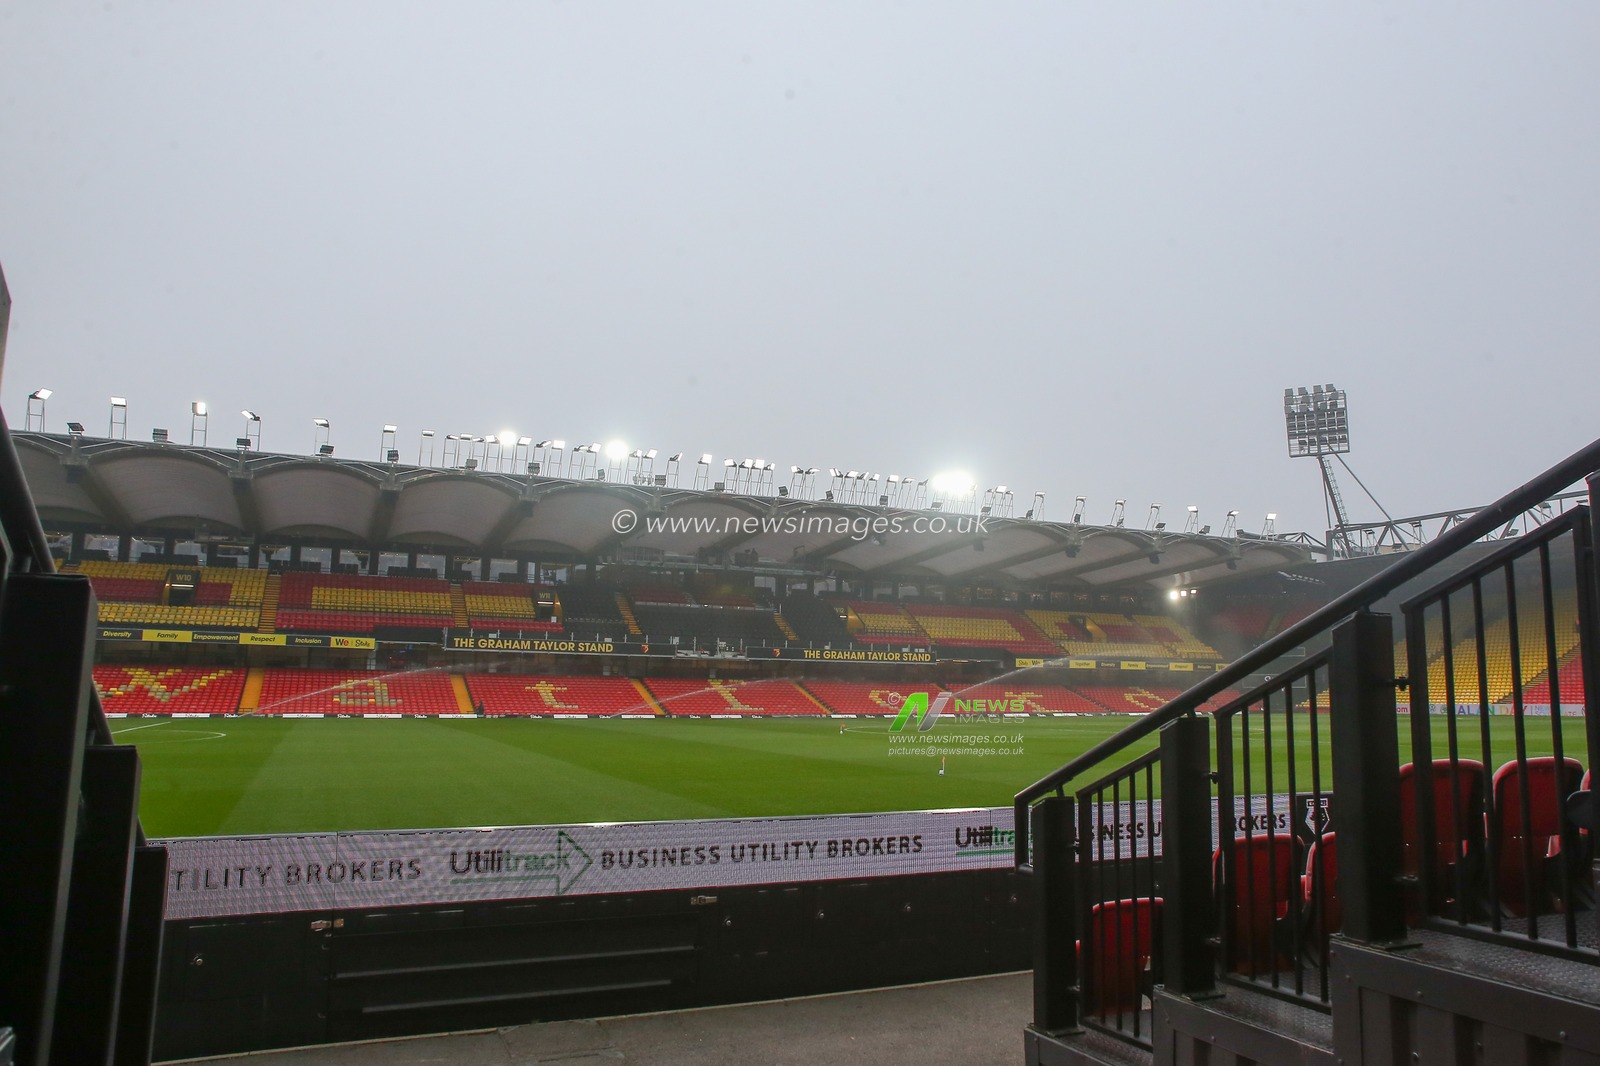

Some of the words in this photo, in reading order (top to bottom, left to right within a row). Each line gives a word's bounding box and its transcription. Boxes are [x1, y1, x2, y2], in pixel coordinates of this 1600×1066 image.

[102, 630, 132, 639] Diversity
[156, 632, 179, 640] Family
[250, 635, 276, 643] Respect
[453, 637, 475, 648] THE
[477, 639, 531, 650] GRAHAM
[533, 640, 575, 651] TAYLOR
[577, 642, 614, 653] STAND
[803, 649, 821, 659] THE
[823, 650, 865, 660] GRAHAM
[867, 651, 901, 661] TAYLOR
[902, 652, 931, 662] STAND
[171, 864, 273, 891] TILITY
[285, 857, 422, 886] BROKERS
[450, 848, 571, 874] Utilitrack
[601, 844, 721, 871] BUSINESS
[730, 840, 819, 863] UTILITY
[826, 834, 923, 859] BROKERS
[1234, 813, 1287, 832] OKERS
